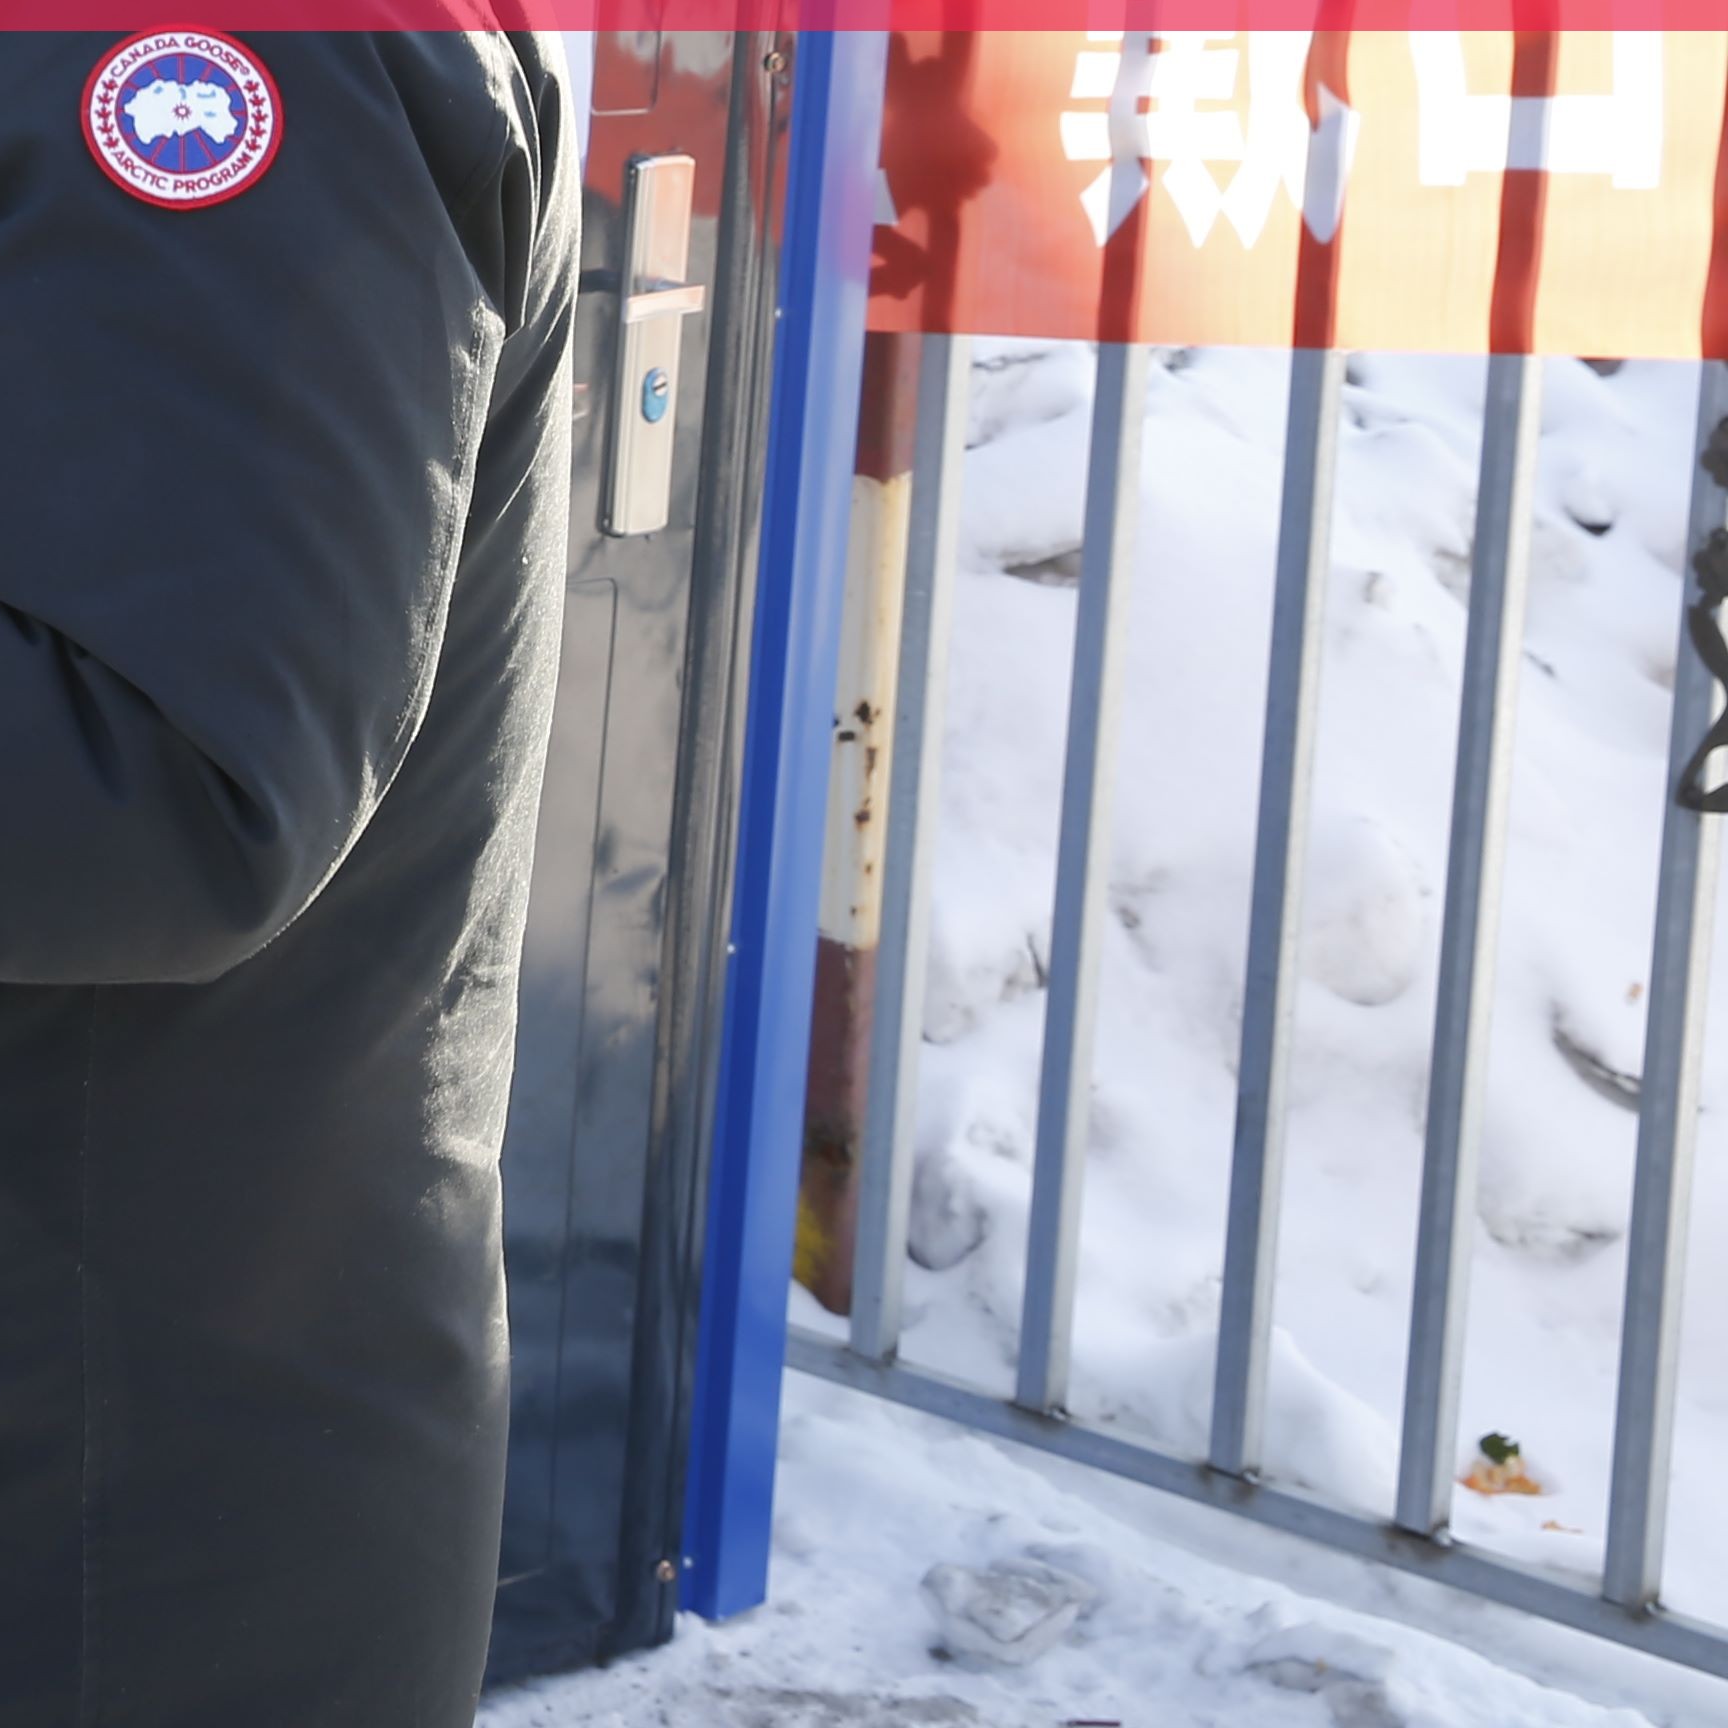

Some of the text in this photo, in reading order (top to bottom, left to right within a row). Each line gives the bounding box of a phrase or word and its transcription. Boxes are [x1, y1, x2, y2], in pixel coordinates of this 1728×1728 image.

[110, 36, 180, 79] CANADA
[112, 150, 253, 193] ARCTIC PROGRAM
